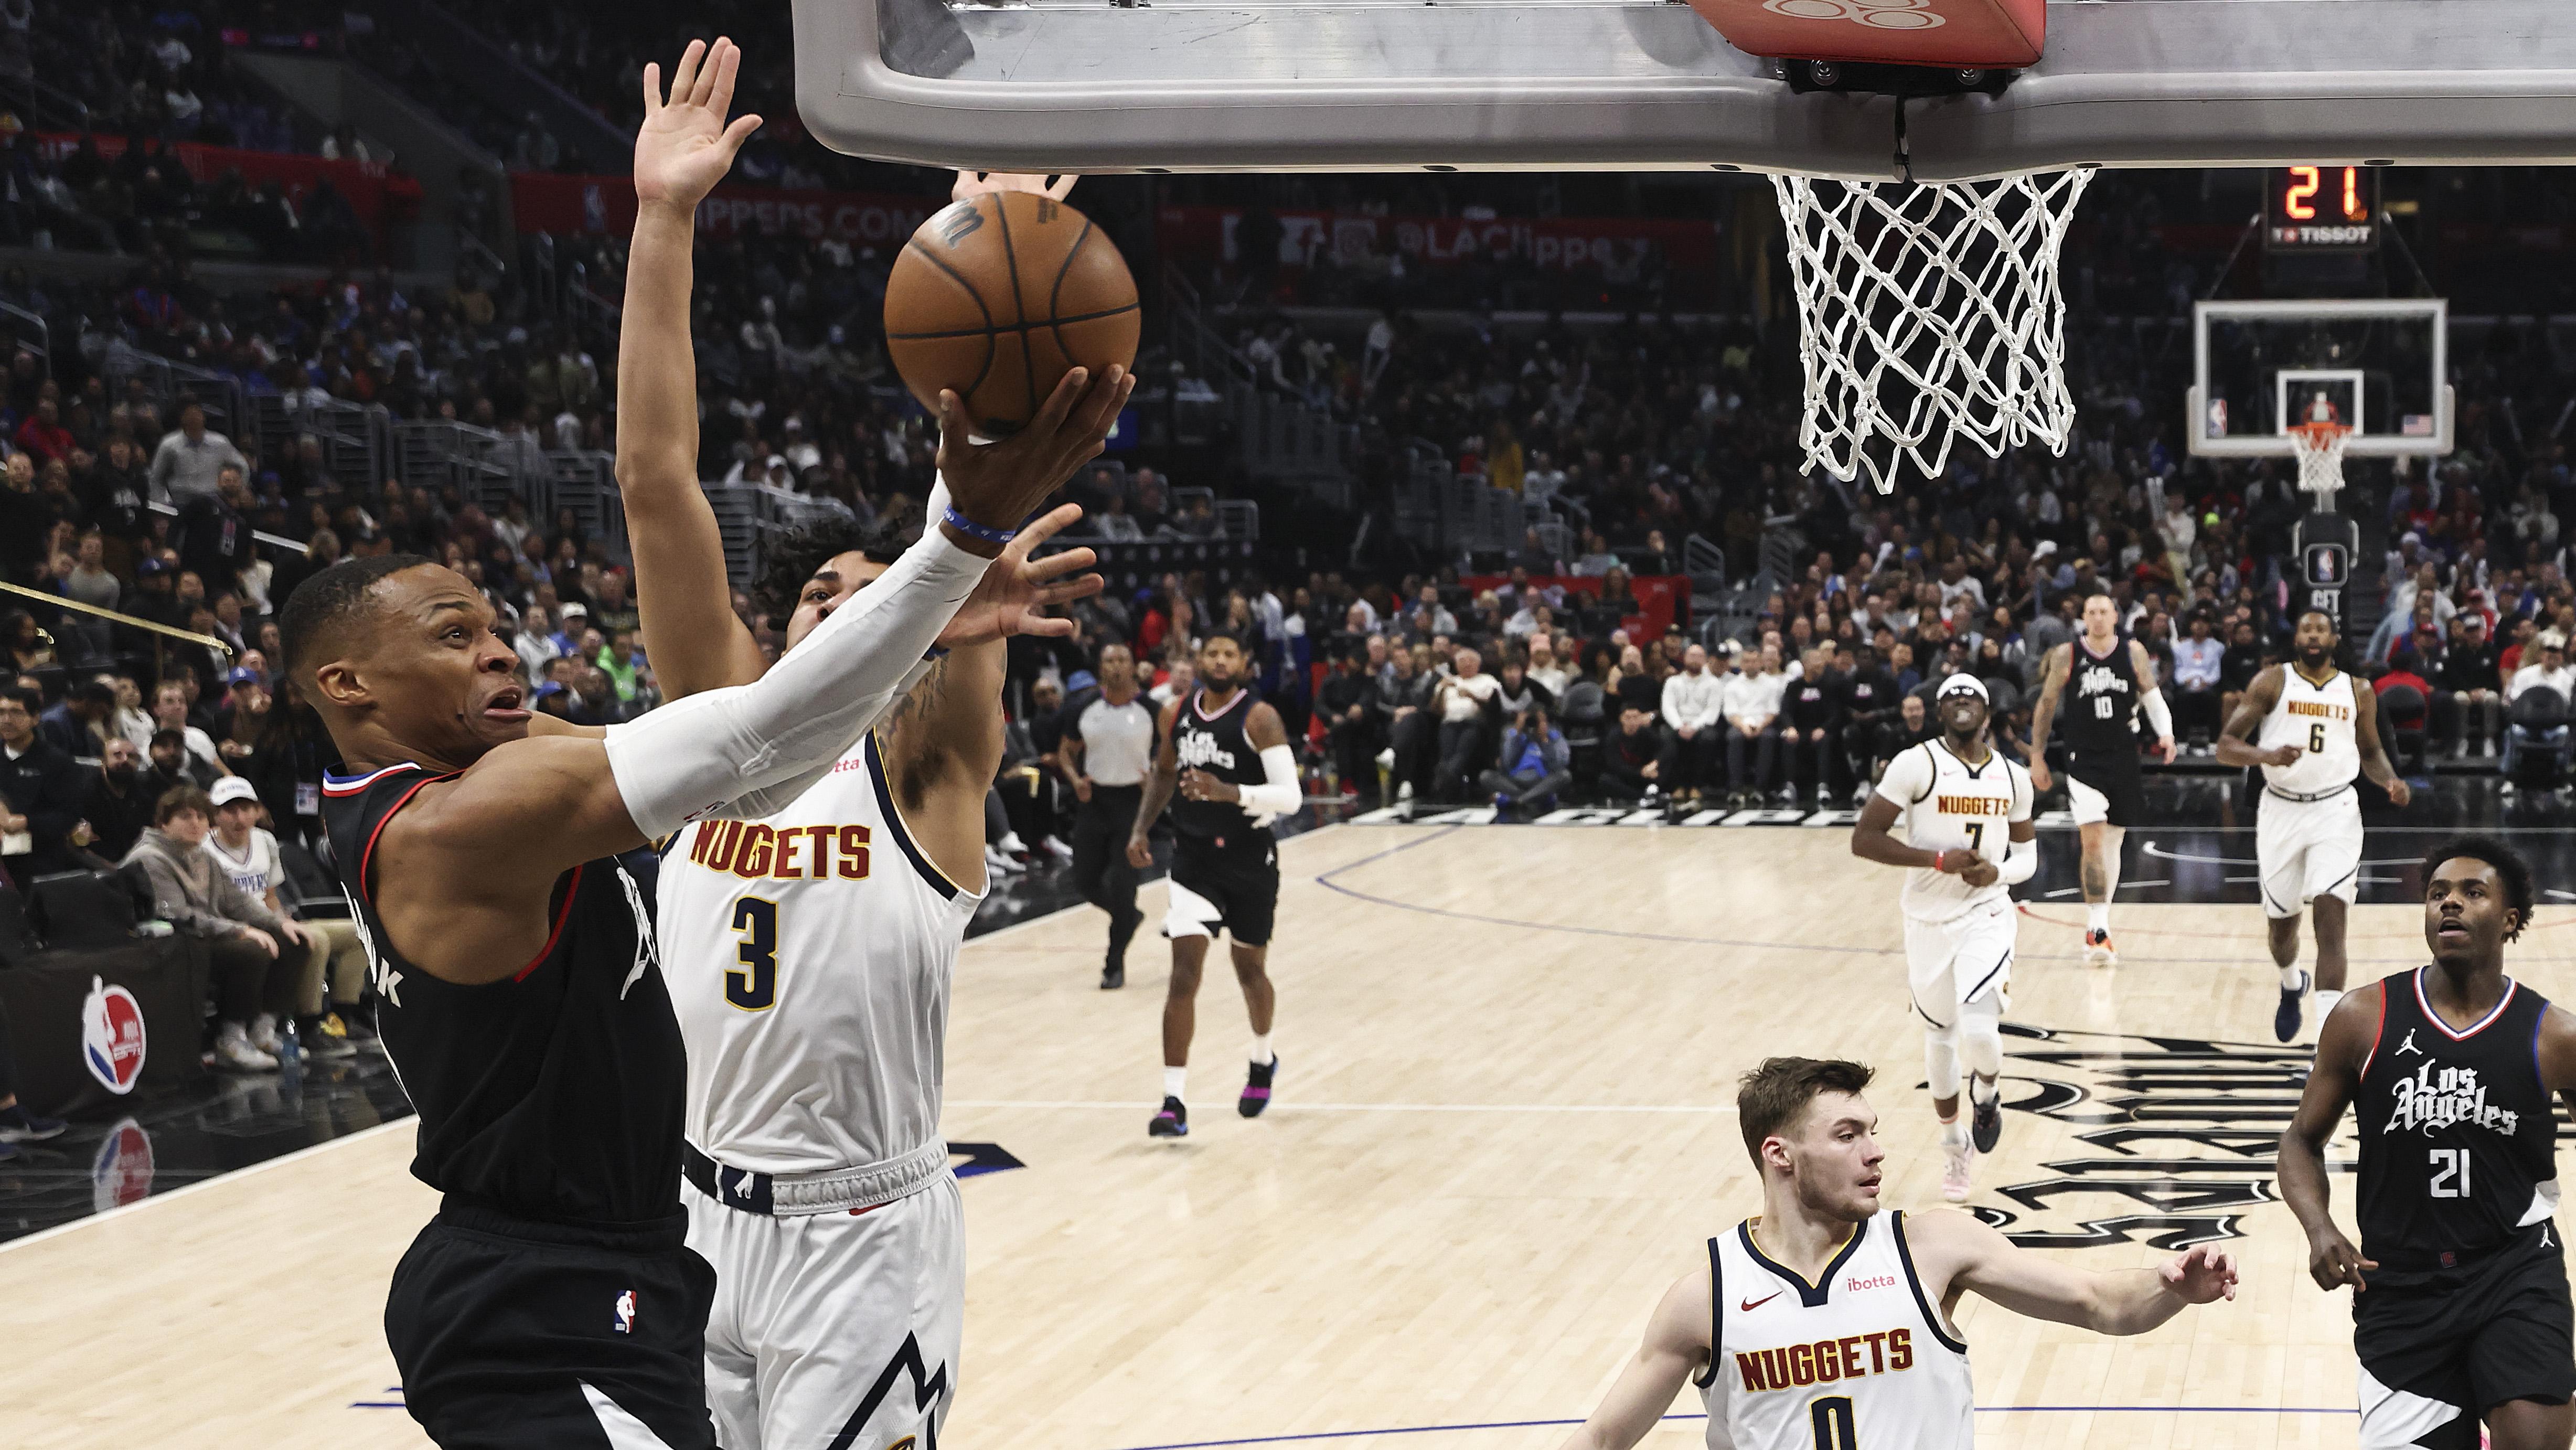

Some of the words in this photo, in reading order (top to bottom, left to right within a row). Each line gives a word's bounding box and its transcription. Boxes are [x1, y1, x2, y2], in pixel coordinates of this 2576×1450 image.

[2285, 165, 2356, 219] 21
[2094, 696, 2113, 719] 10
[2309, 722, 2325, 753] 6
[1938, 795, 2010, 816] NUGGETS
[1965, 822, 1983, 849] 7
[724, 894, 779, 1012] 3
[2414, 1058, 2477, 1097] Los
[2383, 1077, 2519, 1138] Angeles
[2430, 1149, 2471, 1198] 21
[1848, 1275, 1896, 1292] ibotta
[1735, 1328, 1914, 1393] NUGGETS
